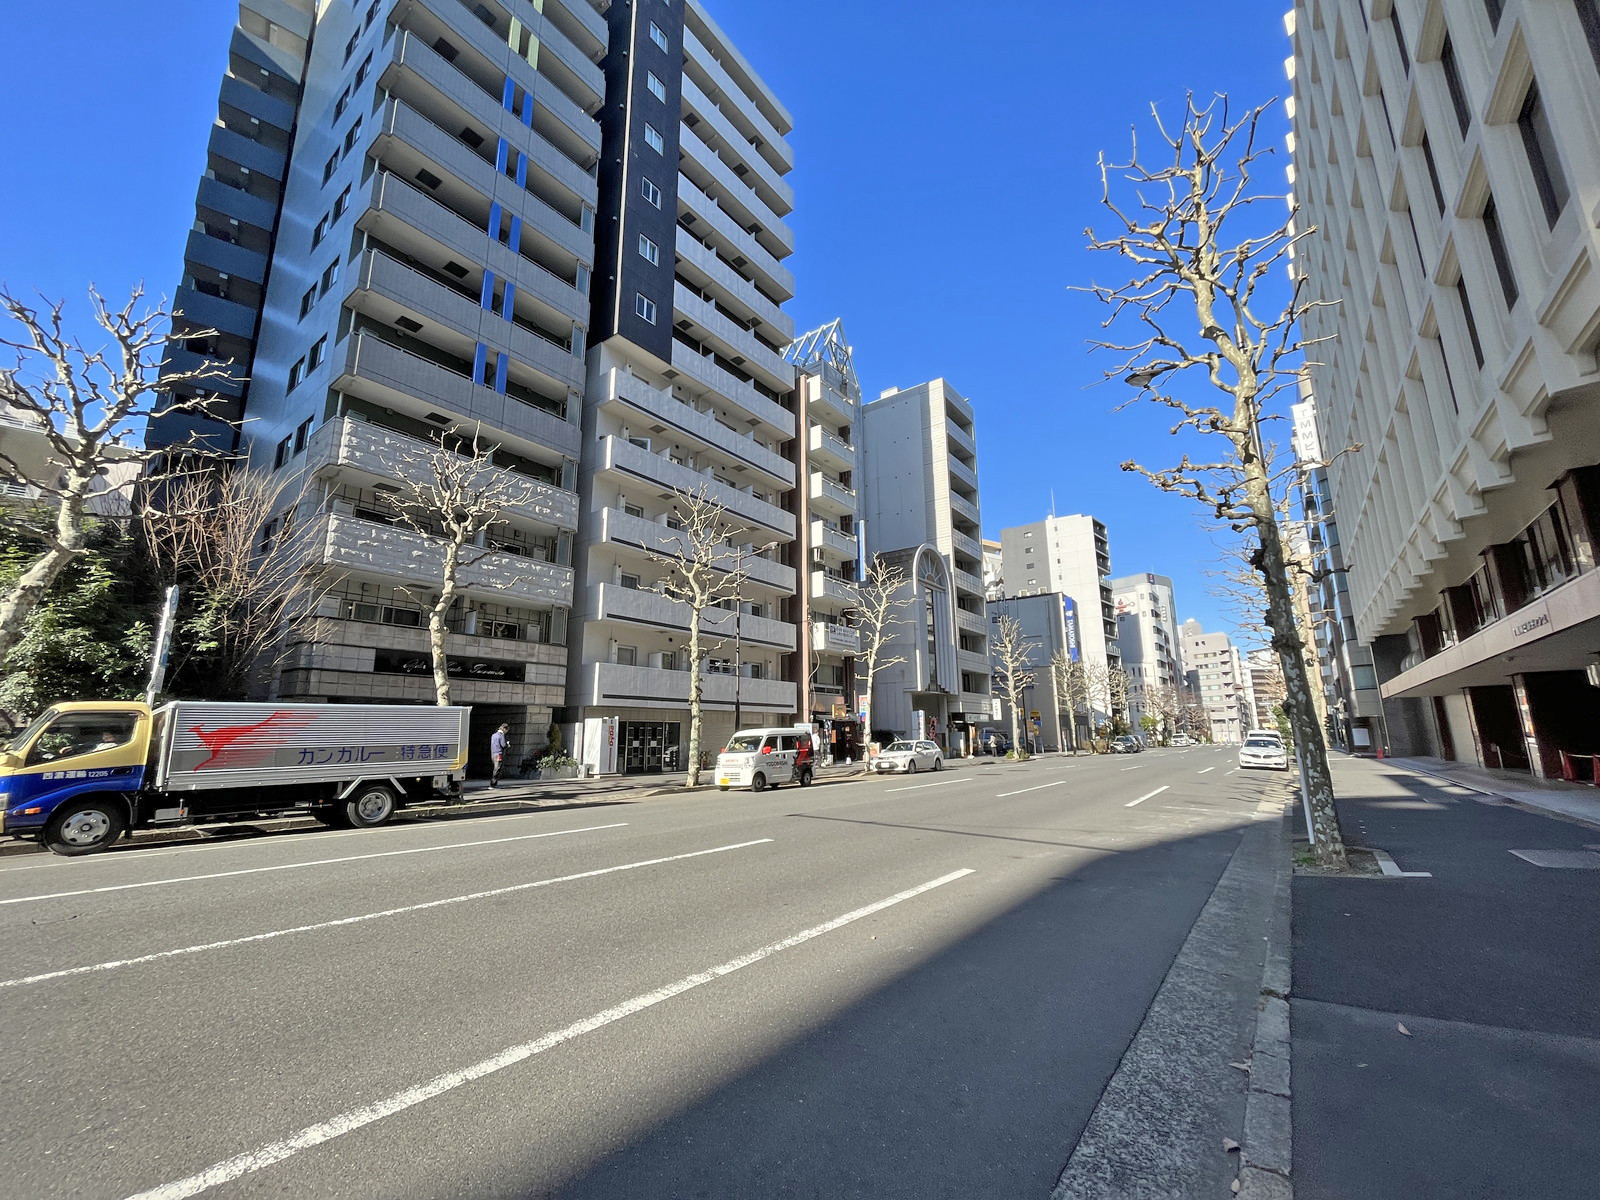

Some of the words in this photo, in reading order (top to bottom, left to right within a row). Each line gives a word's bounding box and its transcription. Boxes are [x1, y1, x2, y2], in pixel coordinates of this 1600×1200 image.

[298, 745, 386, 764] カンガルー
[401, 744, 449, 760] 特急便
[88, 770, 109, 778] 12205
